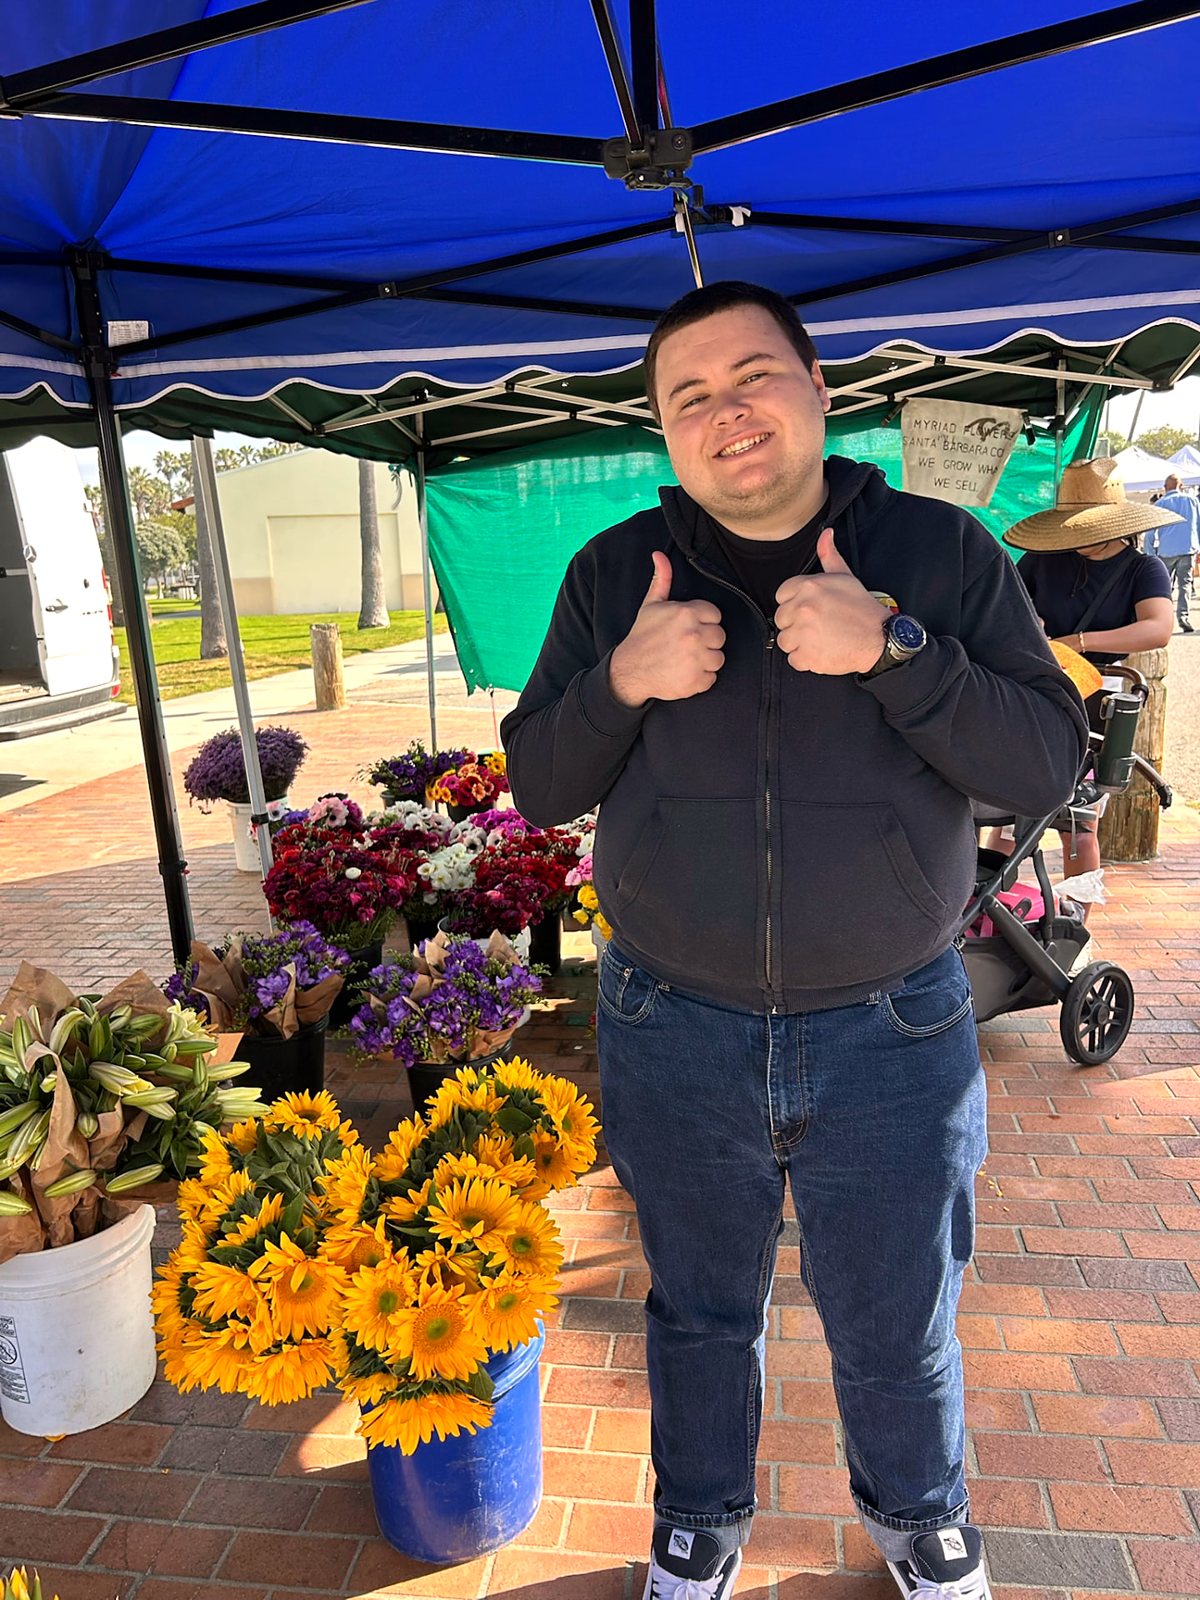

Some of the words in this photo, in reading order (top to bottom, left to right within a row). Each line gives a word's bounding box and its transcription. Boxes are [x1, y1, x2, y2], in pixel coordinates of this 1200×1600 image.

[914, 419, 957, 433] MYRIAD
[902, 436, 937, 448] SANTA
[943, 440, 988, 456] BARBARA
[918, 457, 936, 468] WE
[943, 459, 972, 471] GROW
[978, 465, 999, 475] WHA
[934, 477, 951, 488] WE
